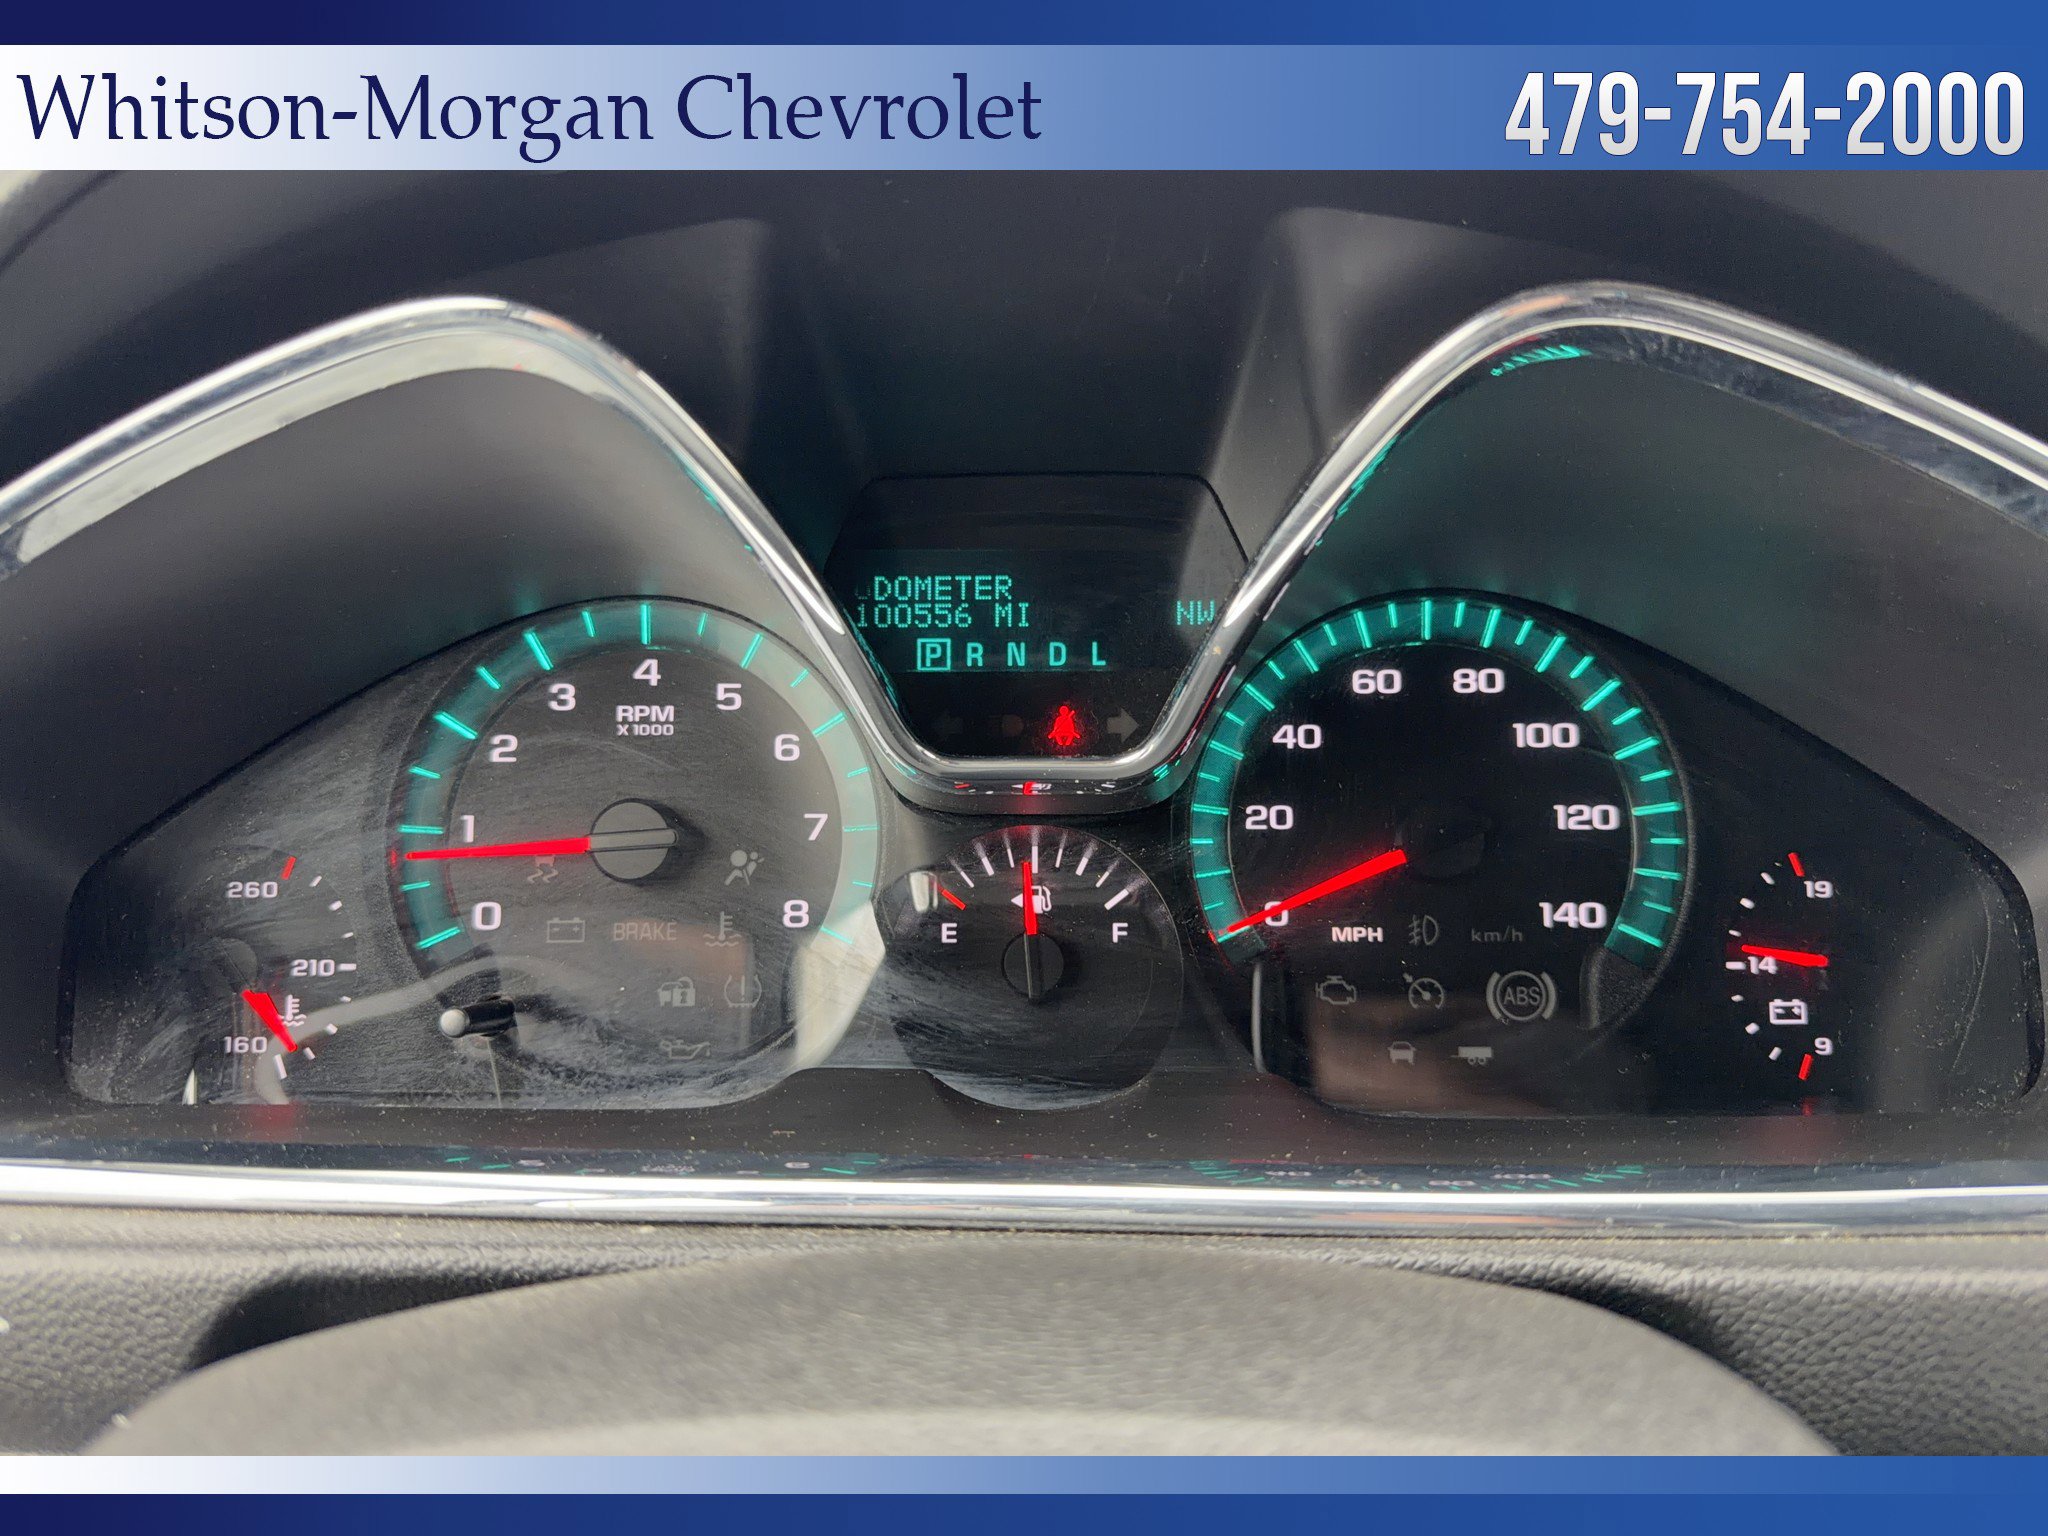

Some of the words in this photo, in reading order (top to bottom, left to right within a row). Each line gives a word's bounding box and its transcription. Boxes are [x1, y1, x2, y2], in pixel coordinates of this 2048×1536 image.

[857, 603, 972, 628] 100556
[995, 603, 1030, 627] MI
[1176, 601, 1214, 626] NW
[925, 643, 943, 667] P
[966, 642, 984, 667] R
[1006, 642, 1026, 667] N
[1049, 642, 1067, 667] D
[1091, 642, 1107, 667] L
[633, 658, 662, 687] 4
[1352, 669, 1402, 695] 60
[1452, 667, 1505, 694] 80
[548, 683, 577, 712] 3
[716, 683, 743, 711] 5
[616, 705, 675, 723] RPM
[489, 734, 519, 763] 2
[774, 734, 801, 762] 6
[1272, 724, 1322, 750] 40
[1513, 722, 1580, 750] 100
[461, 814, 475, 843] 1
[804, 813, 829, 842] 7
[1245, 805, 1295, 831] 20
[1554, 803, 1621, 832] 120
[226, 881, 279, 899] 260
[1803, 880, 1834, 899] 19
[472, 901, 503, 931] 0
[782, 899, 810, 928] 8
[1539, 901, 1607, 930] 140
[612, 922, 678, 942] BRAKE
[941, 922, 958, 943] E
[1112, 922, 1129, 943] F
[1331, 926, 1384, 943] MPH
[1470, 925, 1524, 944] km/h
[290, 958, 337, 977] 210
[1747, 955, 1777, 975] 14
[1503, 984, 1544, 1009] ABS
[224, 1035, 268, 1054] 160
[1814, 1036, 1833, 1056] 9
